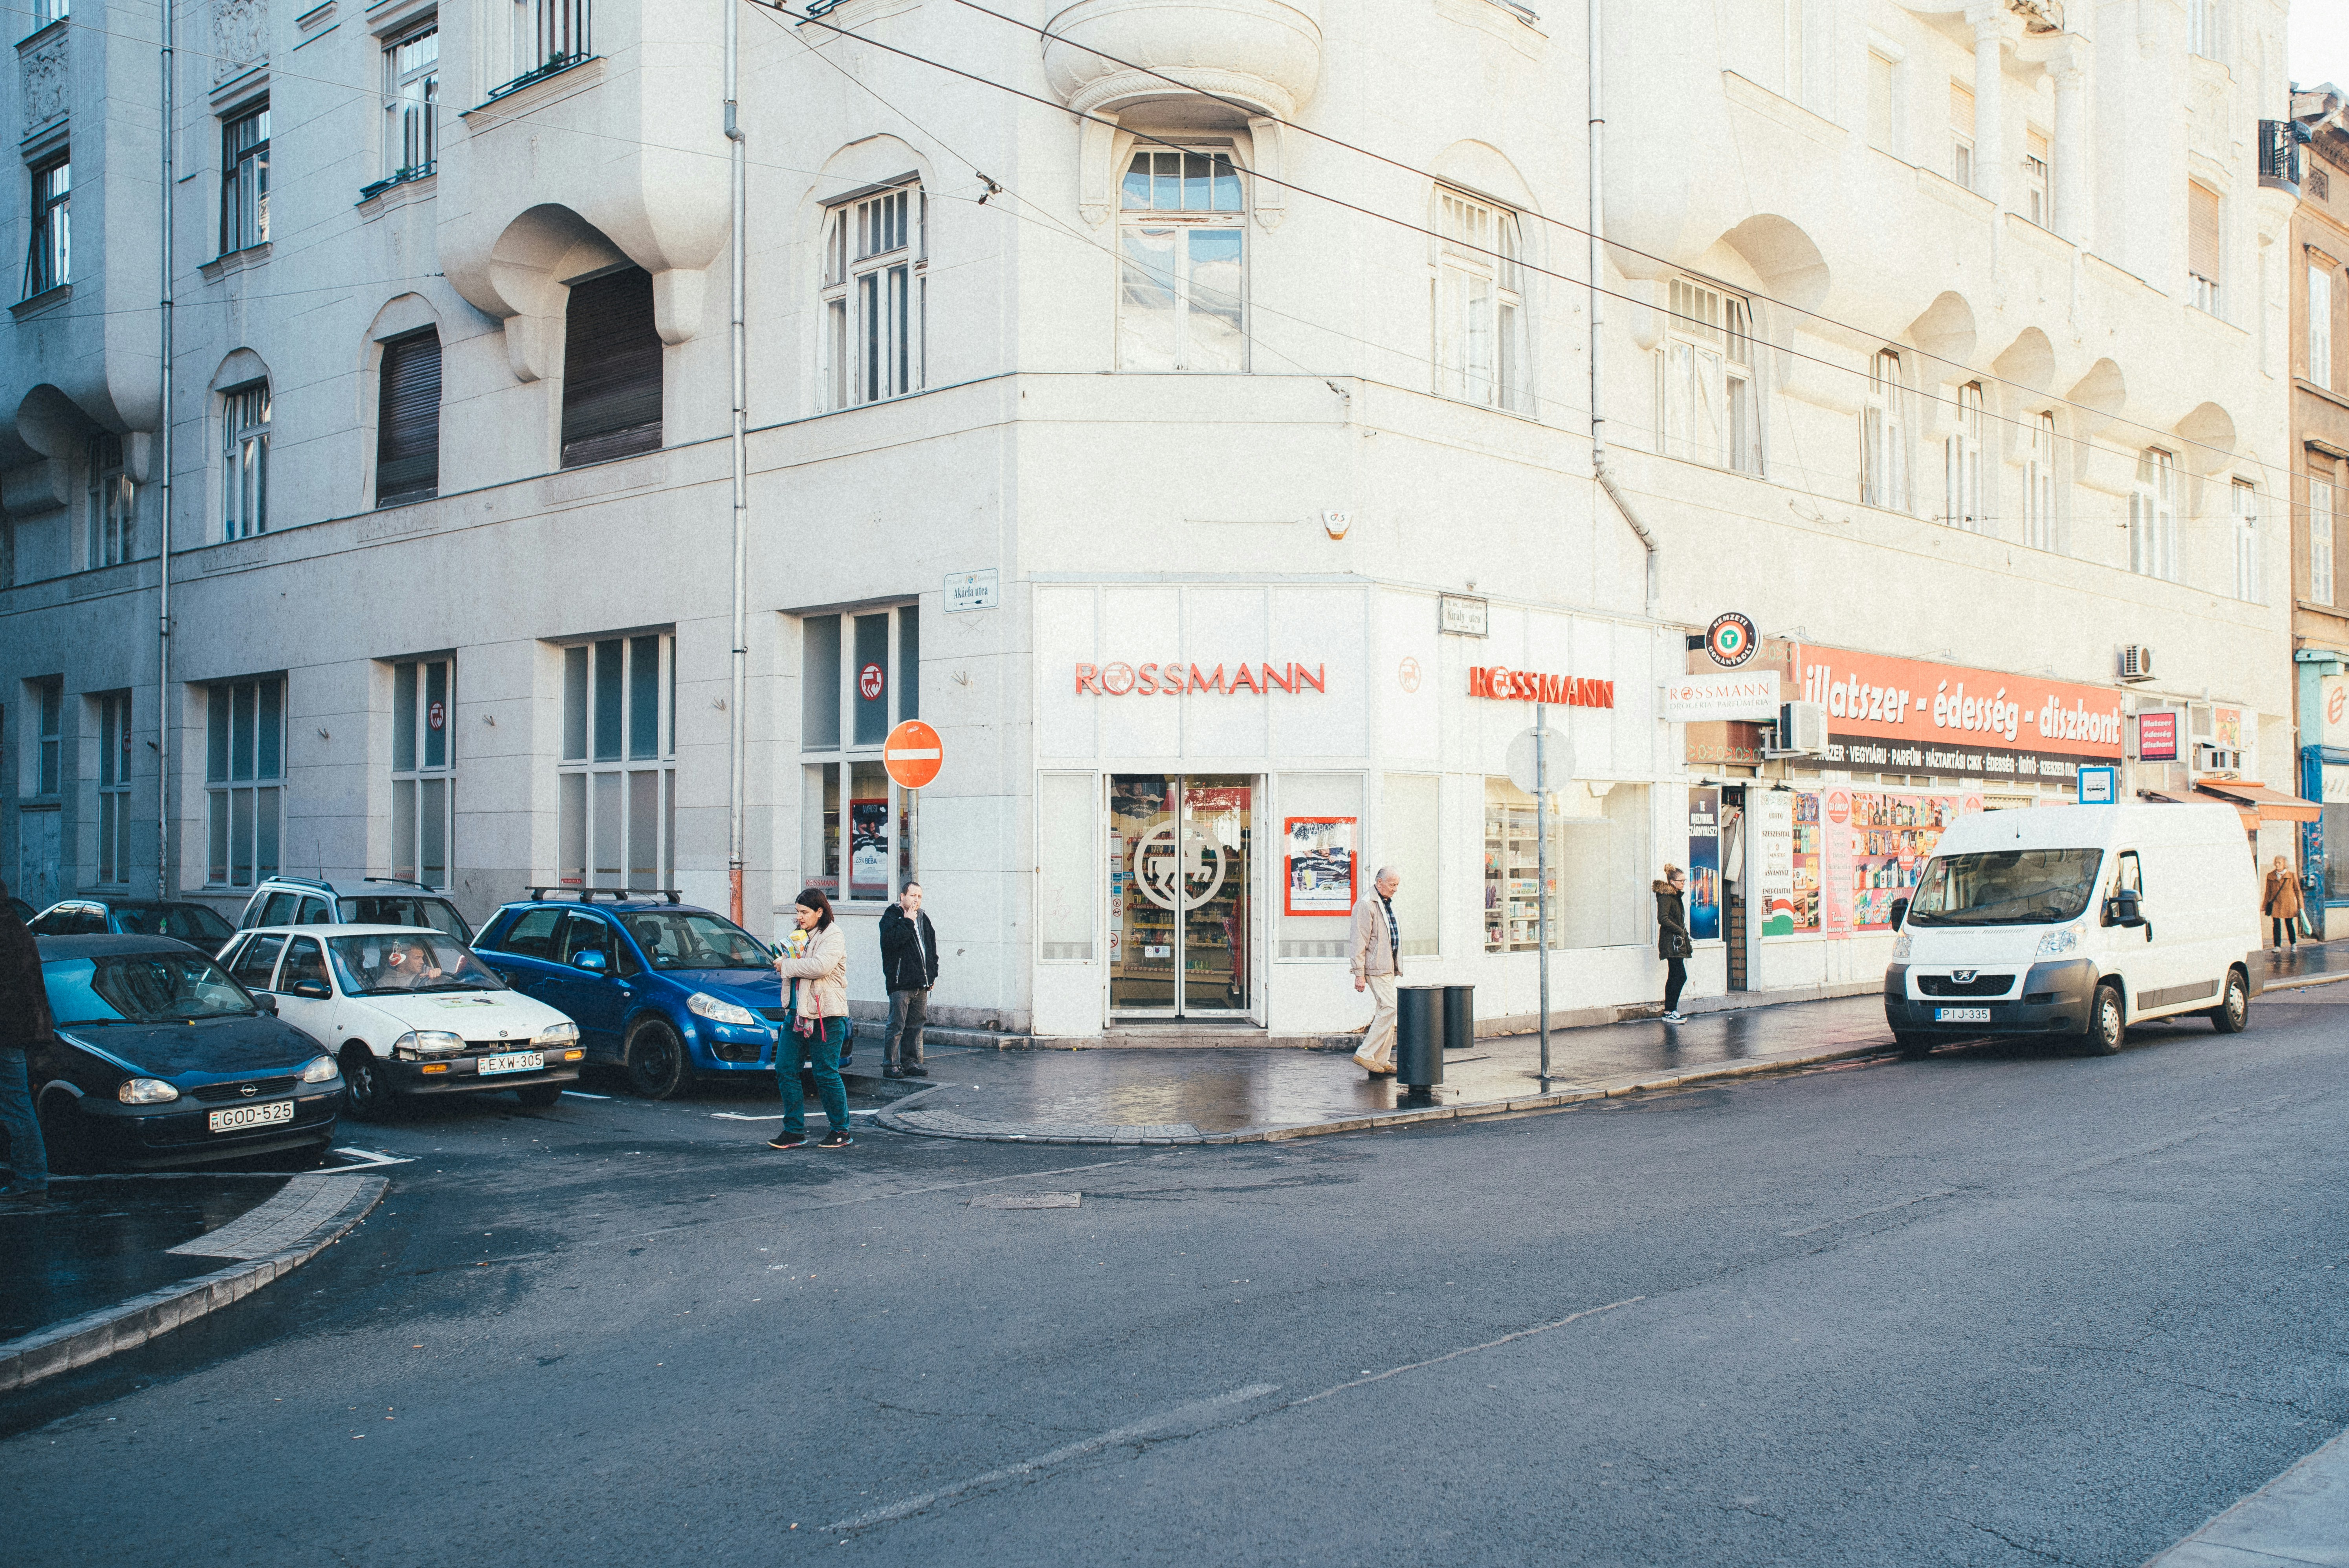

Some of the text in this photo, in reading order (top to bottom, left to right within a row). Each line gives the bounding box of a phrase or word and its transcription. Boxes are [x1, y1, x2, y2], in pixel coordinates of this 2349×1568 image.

[954, 586, 988, 599] Akácfa utca
[1469, 613, 1480, 623] utca
[1713, 614, 1748, 629] NEMZETI
[1724, 634, 1735, 646] T
[1076, 661, 1325, 695] ROSSMANN
[1470, 666, 1614, 709] ROSSMANN
[1670, 683, 1768, 700] ROSSMANN
[1805, 664, 1909, 723] illatszer
[1934, 679, 2019, 742] édesség
[2039, 694, 2121, 745] diszkont
[1849, 743, 1887, 765] VEGYIÁRU
[1925, 748, 1966, 770] HÁZTARTÁSI
[1967, 754, 1982, 771] CIKK
[1986, 750, 2015, 773] ÉDESSÉG
[2040, 759, 2065, 777] SZESZES
[2065, 762, 2078, 777] ITAL
[1699, 800, 1705, 812] TE
[806, 878, 838, 887] ROSSMANN
[1943, 1010, 1988, 1019] PIJ-335
[490, 1054, 542, 1070] EXW-305
[223, 1103, 291, 1125] GOD-525
